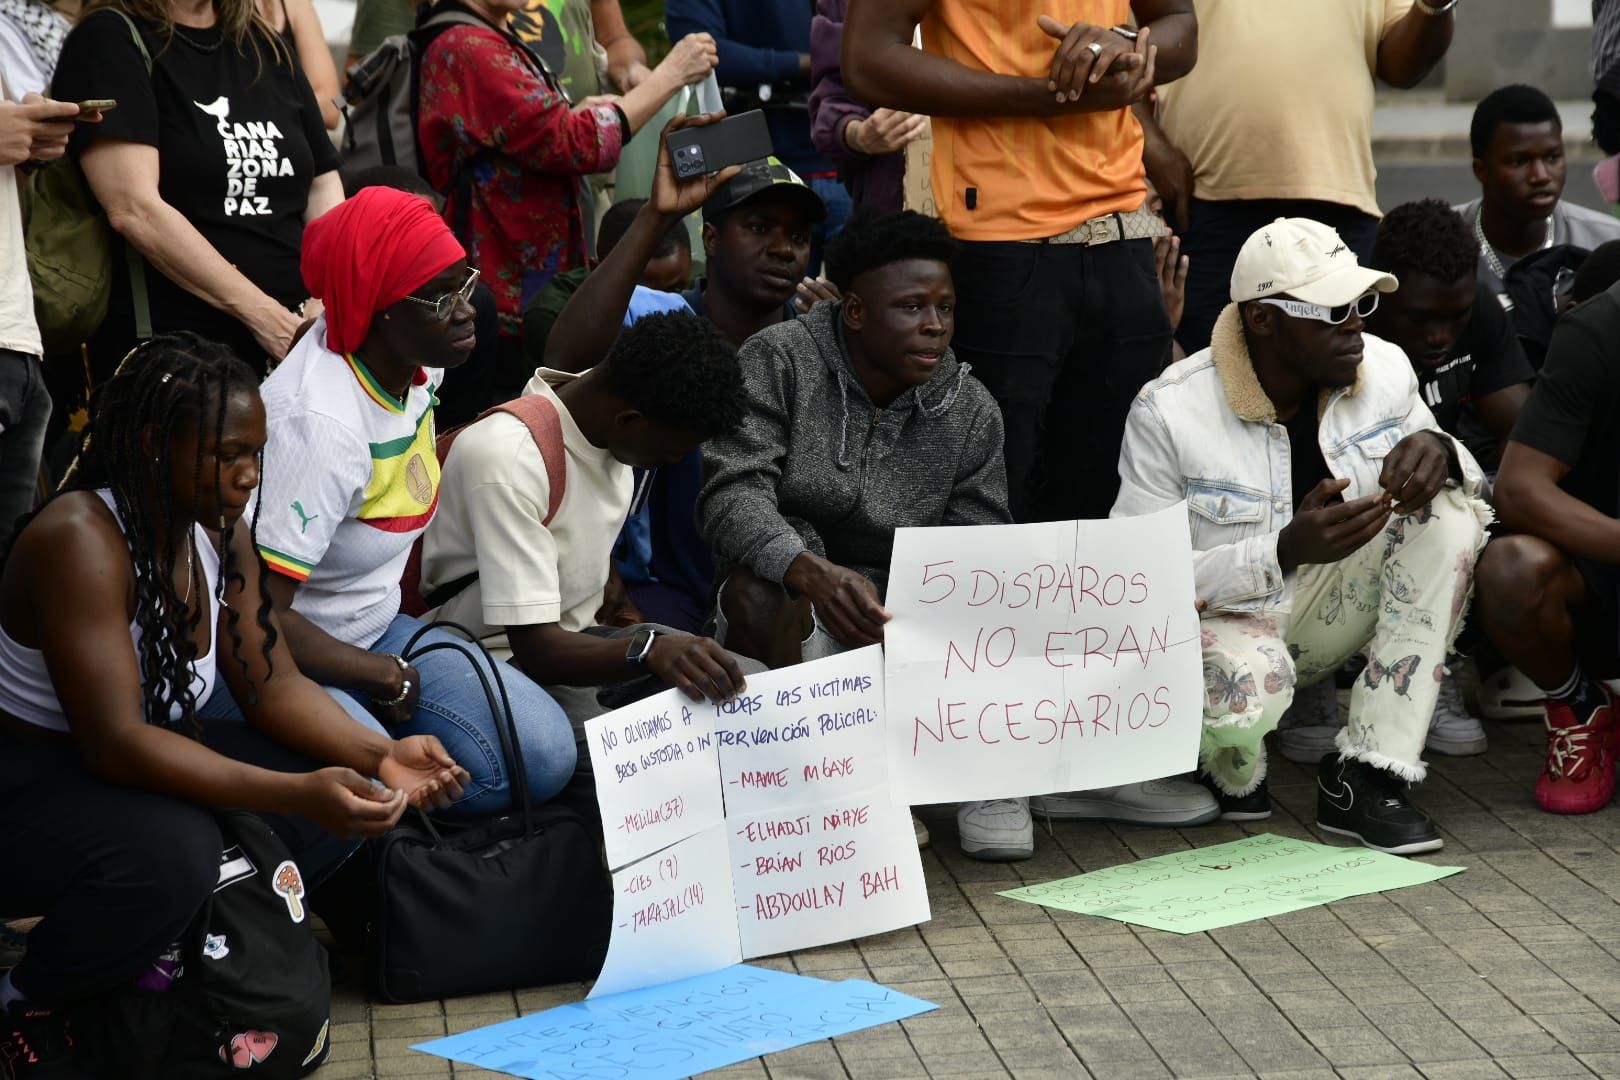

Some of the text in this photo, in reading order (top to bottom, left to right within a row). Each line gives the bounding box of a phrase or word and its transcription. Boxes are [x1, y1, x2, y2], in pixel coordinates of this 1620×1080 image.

[217, 121, 284, 140] CANA
[223, 139, 279, 160] RIAS
[226, 157, 295, 179] ZONA
[226, 177, 257, 198] DE
[223, 196, 273, 217] PAZ
[918, 560, 956, 604] 5
[944, 615, 1170, 680] NO ERAN
[601, 726, 618, 757] NO
[681, 705, 692, 725] A
[712, 694, 763, 718] TODAS
[776, 687, 802, 707] LAS
[859, 864, 899, 899] BAH
